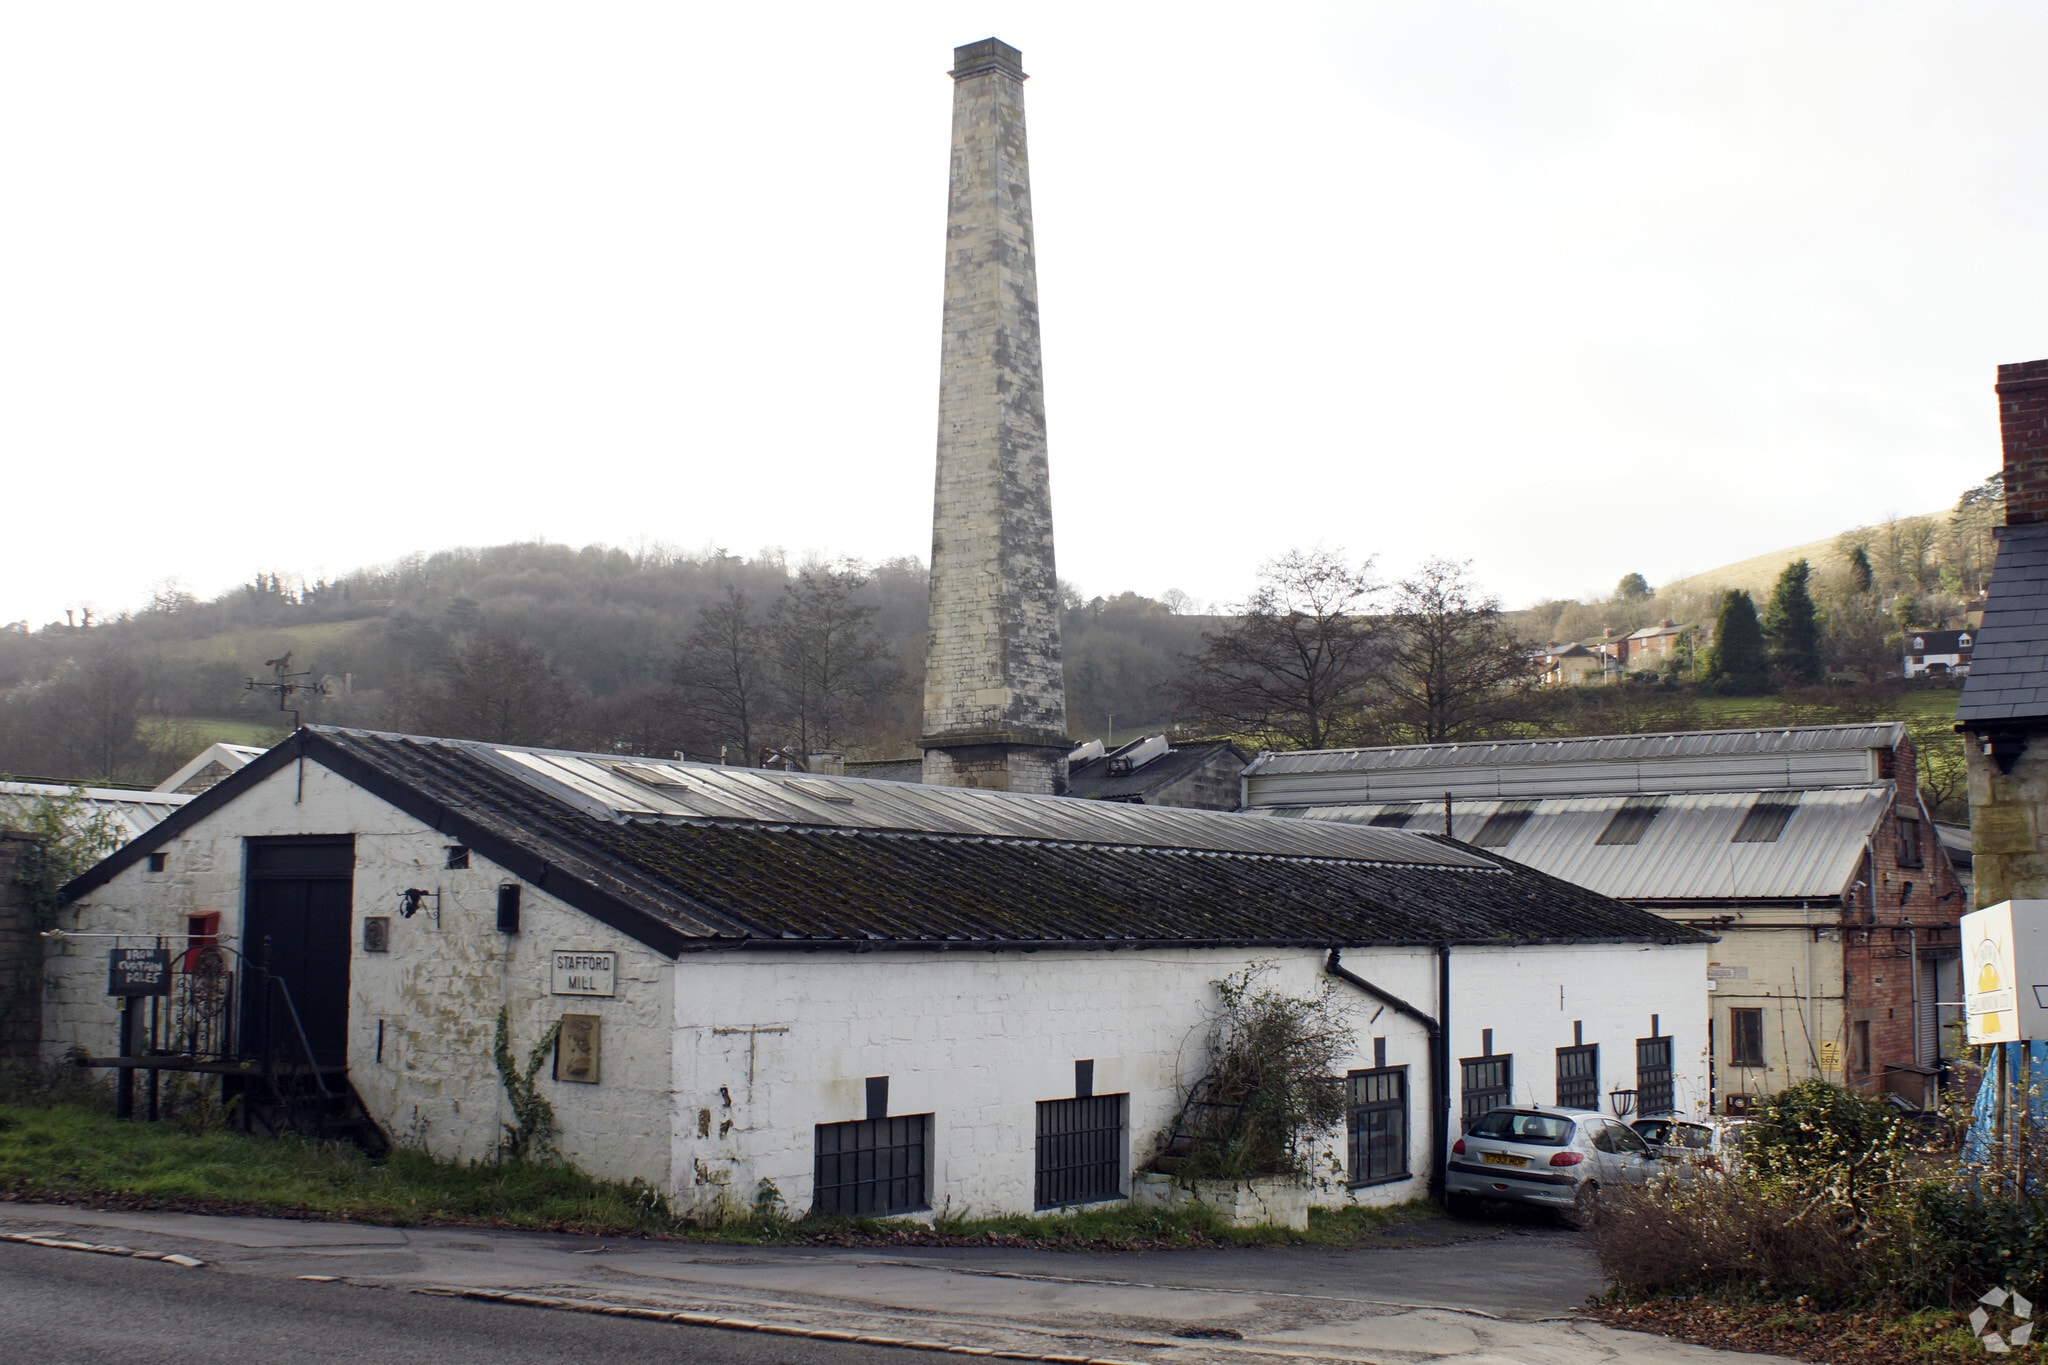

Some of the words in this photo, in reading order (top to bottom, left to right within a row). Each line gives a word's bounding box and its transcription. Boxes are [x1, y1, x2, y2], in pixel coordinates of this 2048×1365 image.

[126, 949, 155, 960] IRON
[118, 960, 163, 972] CURTAIN
[556, 955, 610, 971] STAFFORD
[126, 971, 162, 984] POLES
[568, 975, 597, 991] MILL
